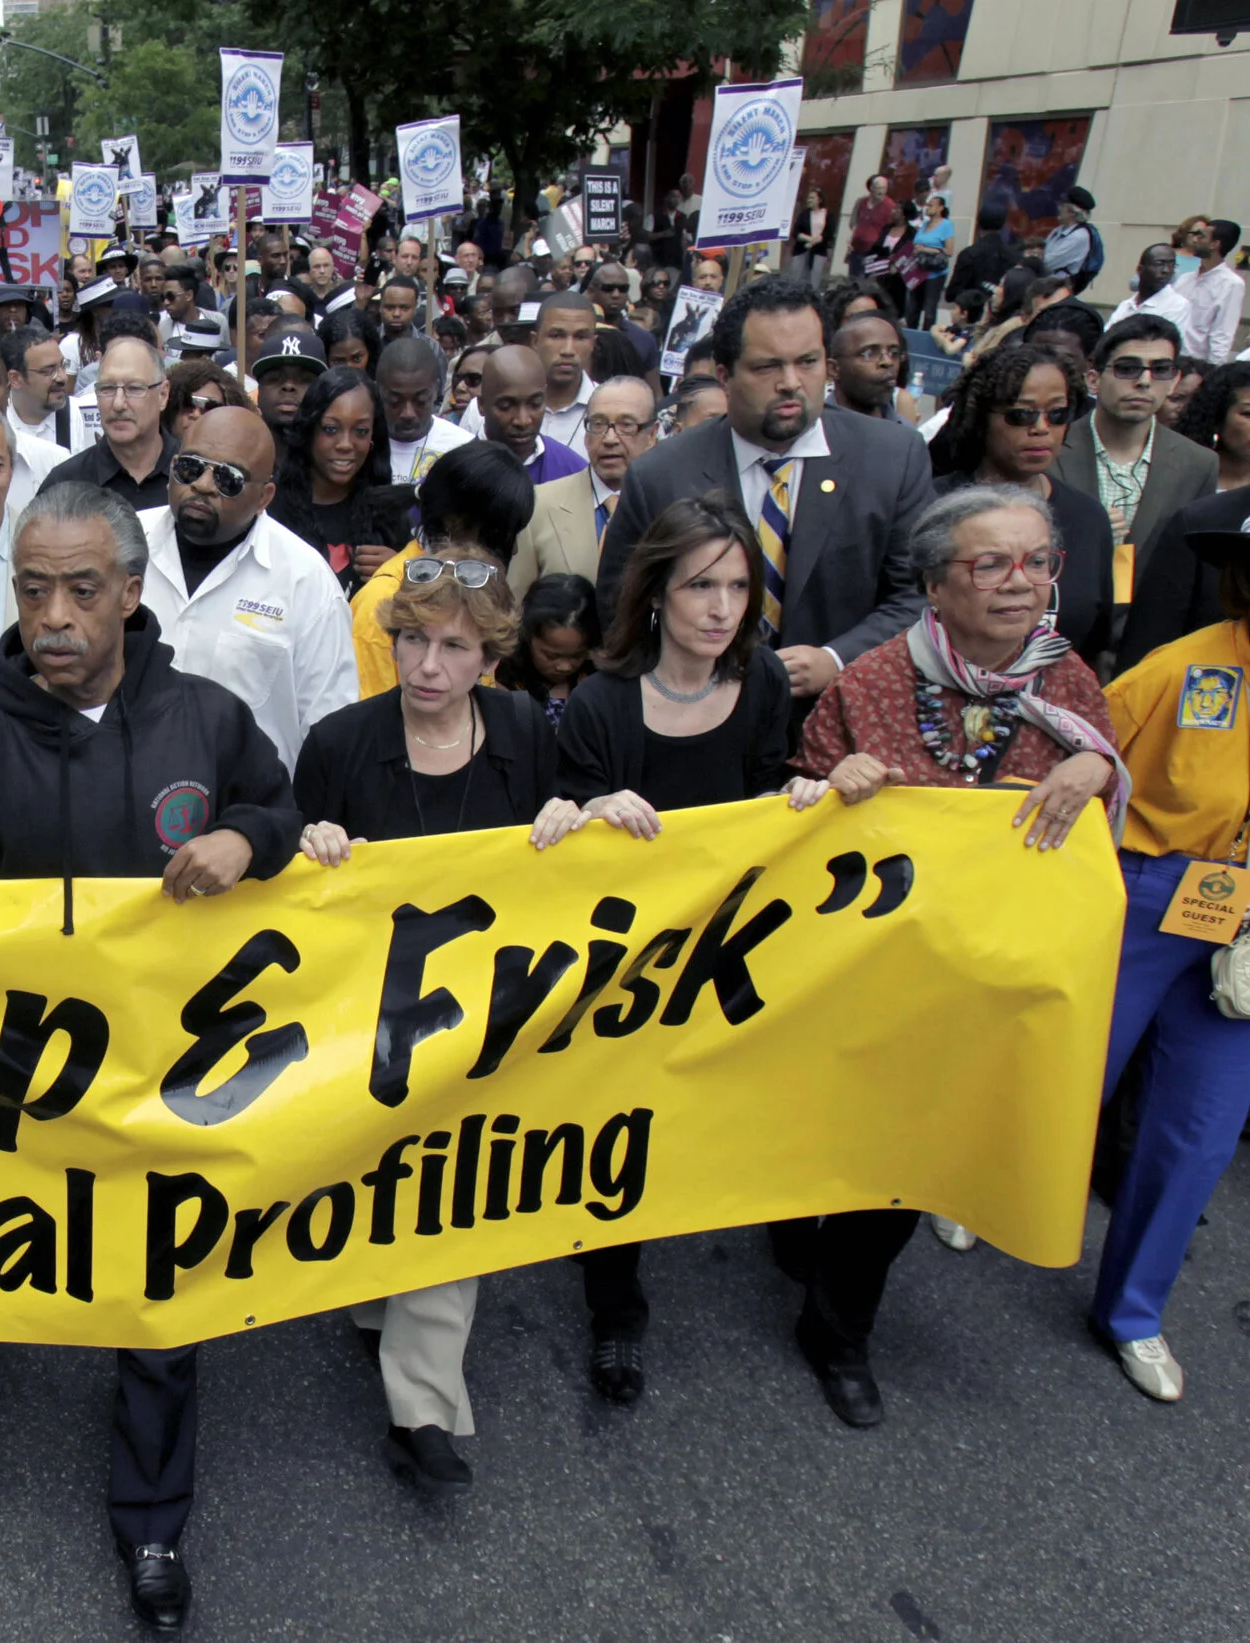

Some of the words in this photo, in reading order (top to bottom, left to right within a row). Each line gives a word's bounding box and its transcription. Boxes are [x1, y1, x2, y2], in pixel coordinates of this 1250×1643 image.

[728, 108, 759, 137] SILENT
[587, 180, 603, 193] THIS
[604, 180, 611, 193] IS
[613, 180, 618, 193] A
[590, 199, 615, 212] SILENT
[590, 217, 616, 231] MARCH
[718, 208, 766, 225] 1199SEIU
[282, 336, 301, 355] NY
[238, 598, 284, 617] 1199SEIU
[1182, 896, 1235, 915] SPECIAL
[1182, 910, 1226, 926] GUEST
[159, 928, 309, 1126] &
[144, 1108, 654, 1302] Profiling
